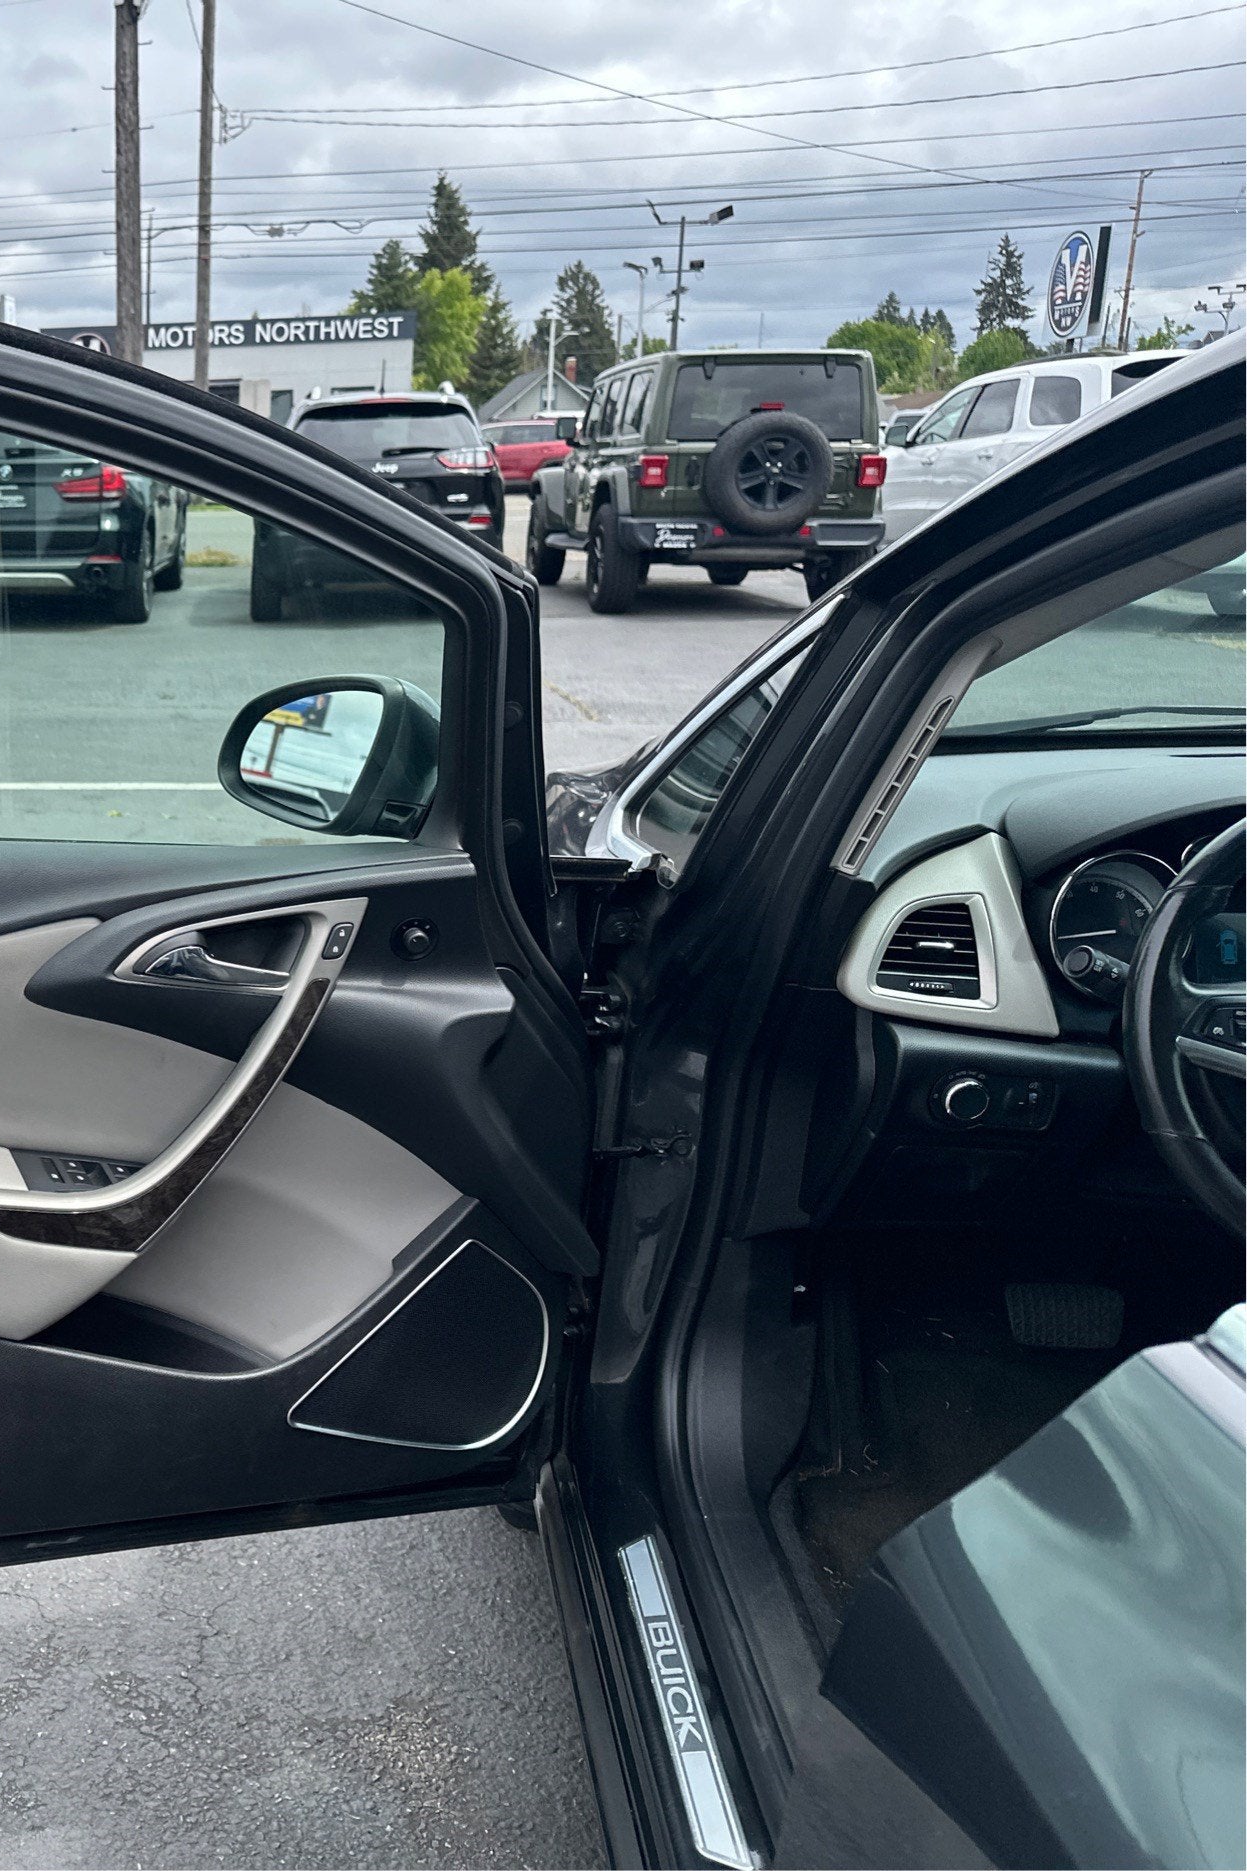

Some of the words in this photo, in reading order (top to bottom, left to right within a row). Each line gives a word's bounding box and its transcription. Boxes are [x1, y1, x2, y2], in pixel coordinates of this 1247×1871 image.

[255, 316, 405, 344] NORTHWEST
[372, 462, 399, 474] Jeep
[646, 1620, 704, 1750] BUICK
